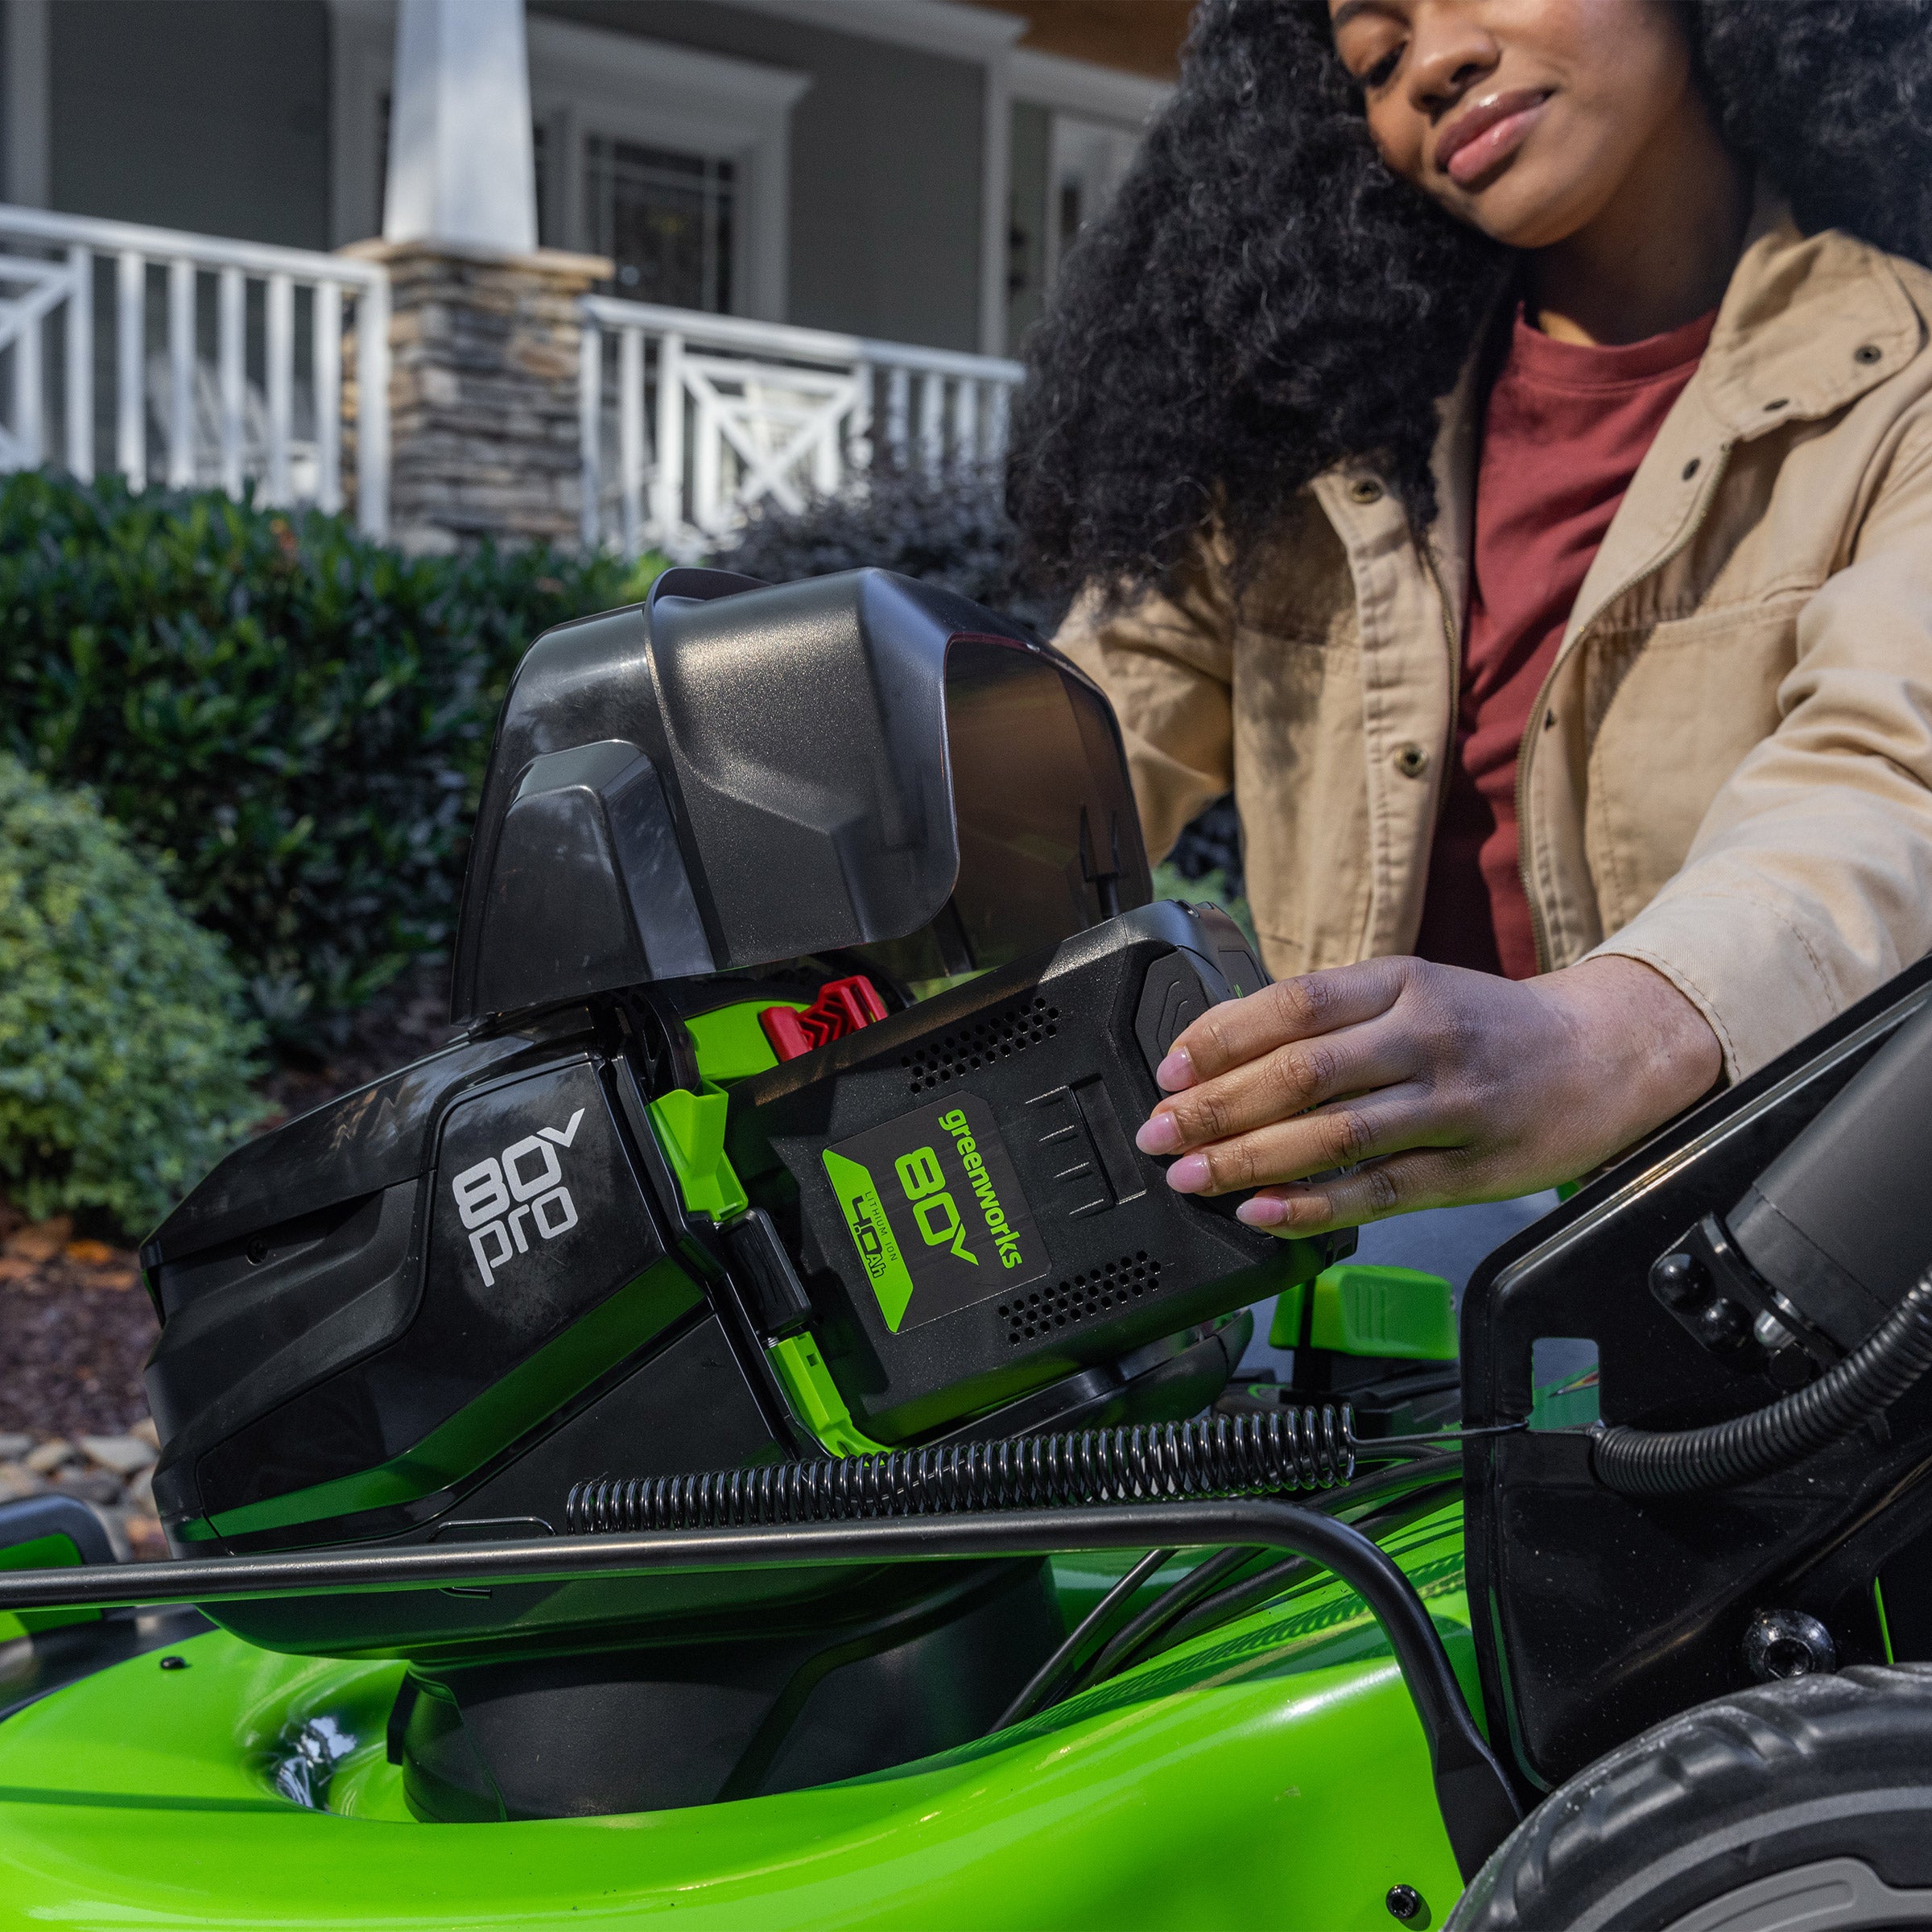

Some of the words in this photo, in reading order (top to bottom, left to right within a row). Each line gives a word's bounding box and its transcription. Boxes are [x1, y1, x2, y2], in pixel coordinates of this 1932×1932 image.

[468, 1186, 579, 1288] pro
[865, 1191, 888, 1236] LITHIUM
[885, 1241, 898, 1261] ION
[938, 1108, 1022, 1269] greenworks
